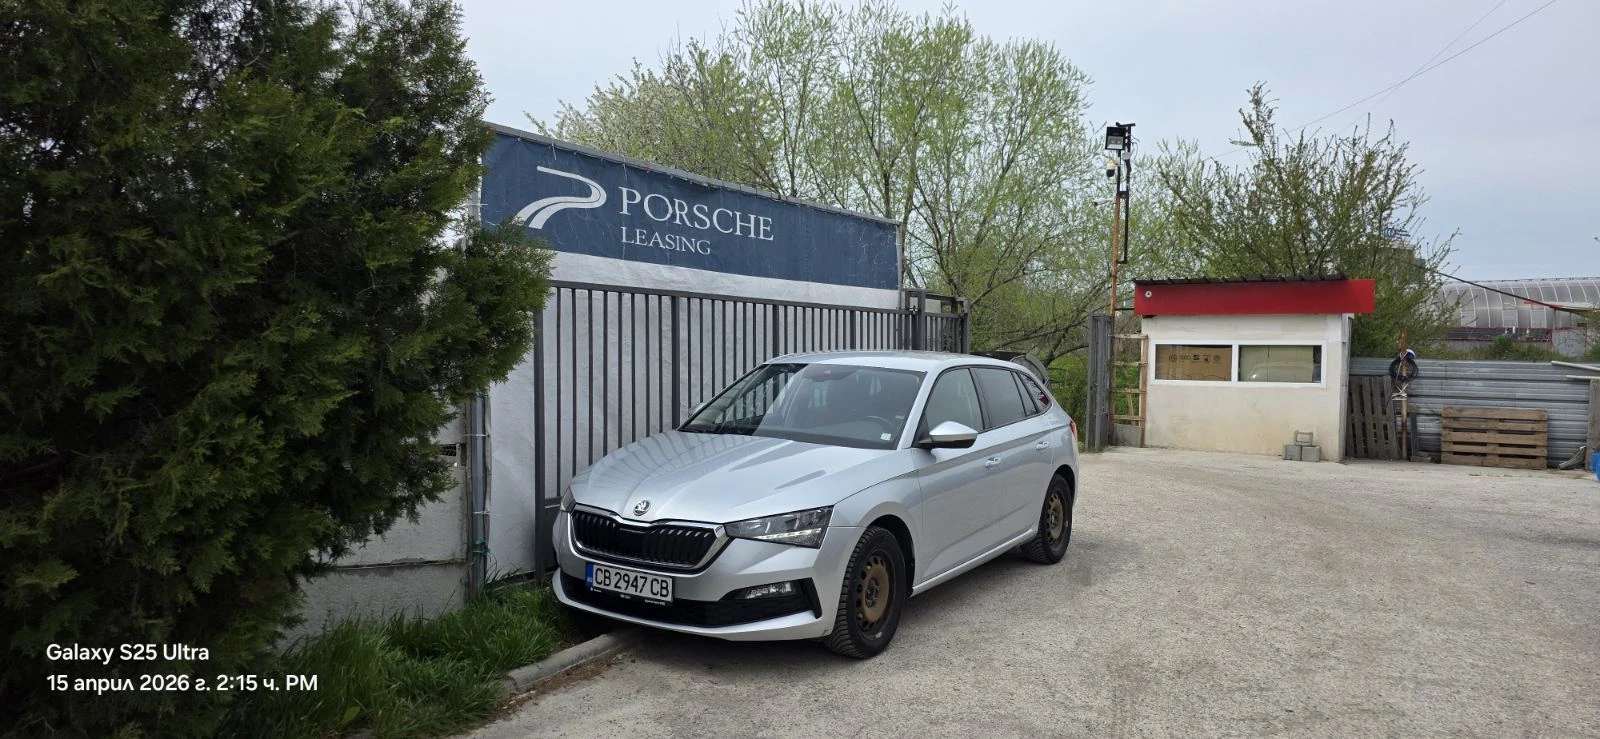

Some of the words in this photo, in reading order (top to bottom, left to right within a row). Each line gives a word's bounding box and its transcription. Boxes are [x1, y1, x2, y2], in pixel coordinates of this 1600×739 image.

[618, 186, 774, 241] PORSCHE
[620, 226, 711, 255] LEASING
[595, 567, 611, 587] CB
[614, 571, 648, 593] 2947
[650, 577, 669, 598] CB
